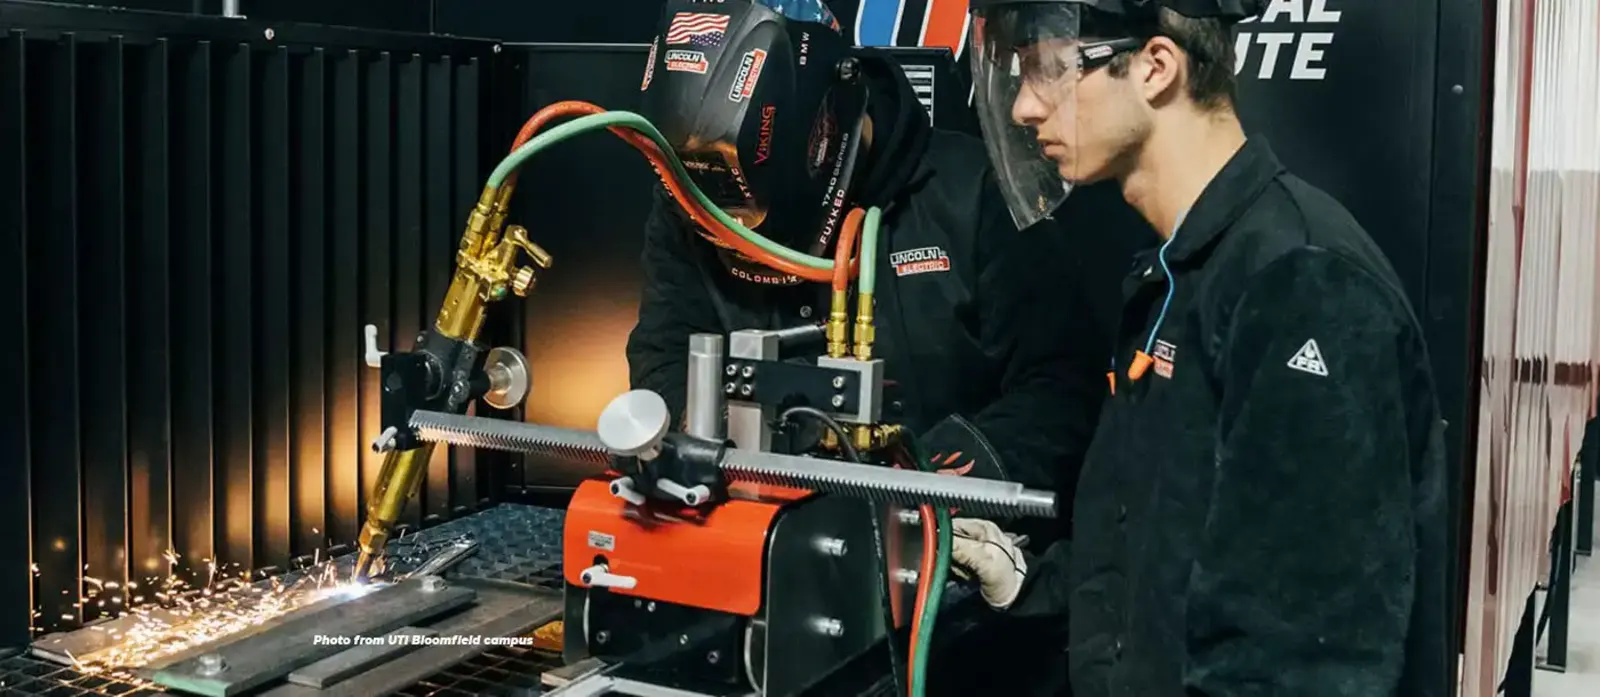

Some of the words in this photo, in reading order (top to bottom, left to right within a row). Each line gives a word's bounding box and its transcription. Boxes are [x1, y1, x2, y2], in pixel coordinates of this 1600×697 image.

[1237, 0, 1342, 22] AL
[731, 56, 754, 99] LINCOLN
[821, 177, 838, 207] 1740
[819, 188, 846, 245] FUXKED
[890, 248, 938, 266] LINCOLN
